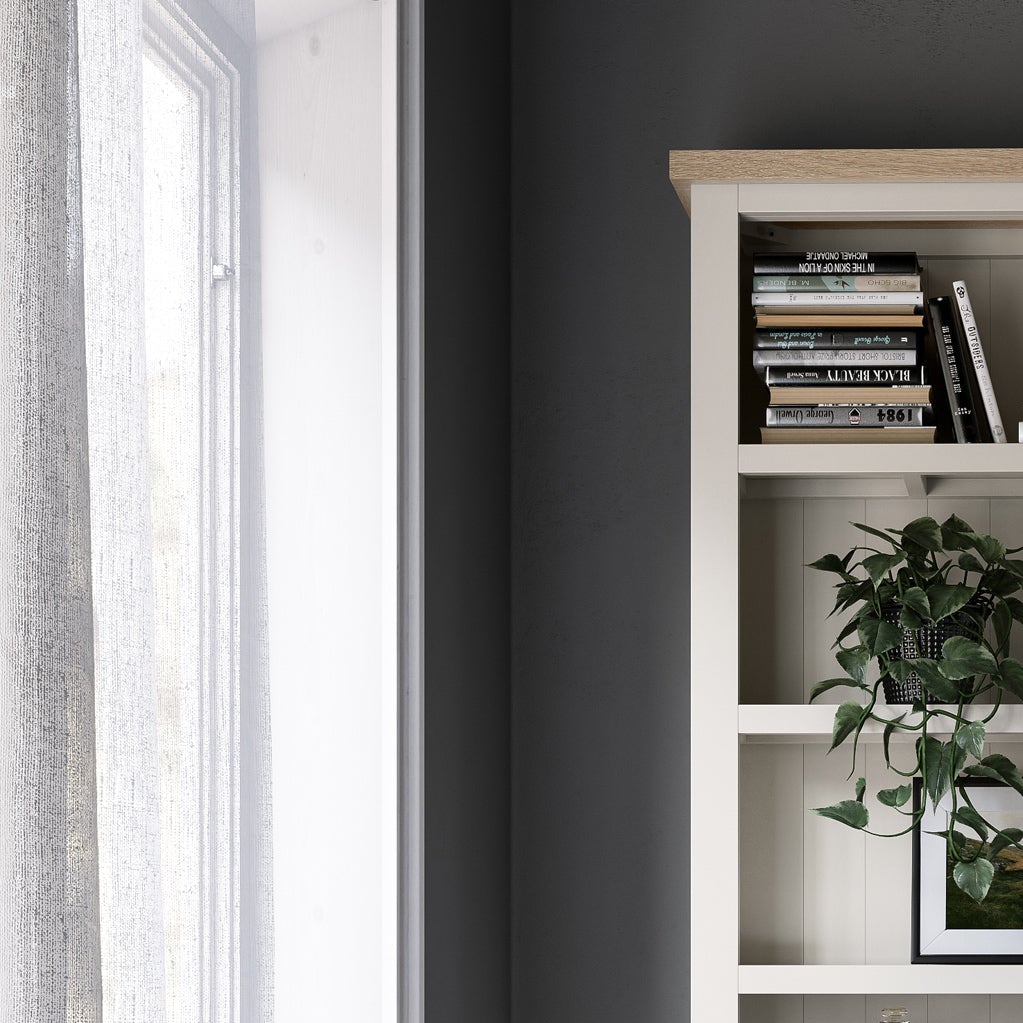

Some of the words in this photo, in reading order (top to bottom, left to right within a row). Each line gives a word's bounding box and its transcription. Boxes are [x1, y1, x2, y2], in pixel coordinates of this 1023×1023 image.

[806, 252, 839, 260] ONDAATJE
[841, 252, 867, 260] MICHAEL
[799, 263, 816, 272] LION
[817, 263, 822, 272] A
[823, 263, 833, 272] OF
[835, 263, 851, 272] SKIN
[852, 263, 865, 272] THE
[867, 263, 874, 272] IN
[769, 332, 788, 340] London
[873, 336, 890, 345] George
[968, 327, 984, 369] OUTSIDERS
[826, 370, 869, 381] BEAUTY
[873, 370, 910, 381] BLACK
[775, 410, 803, 423] Orwell
[806, 409, 834, 423] George
[877, 409, 913, 422] 1984
